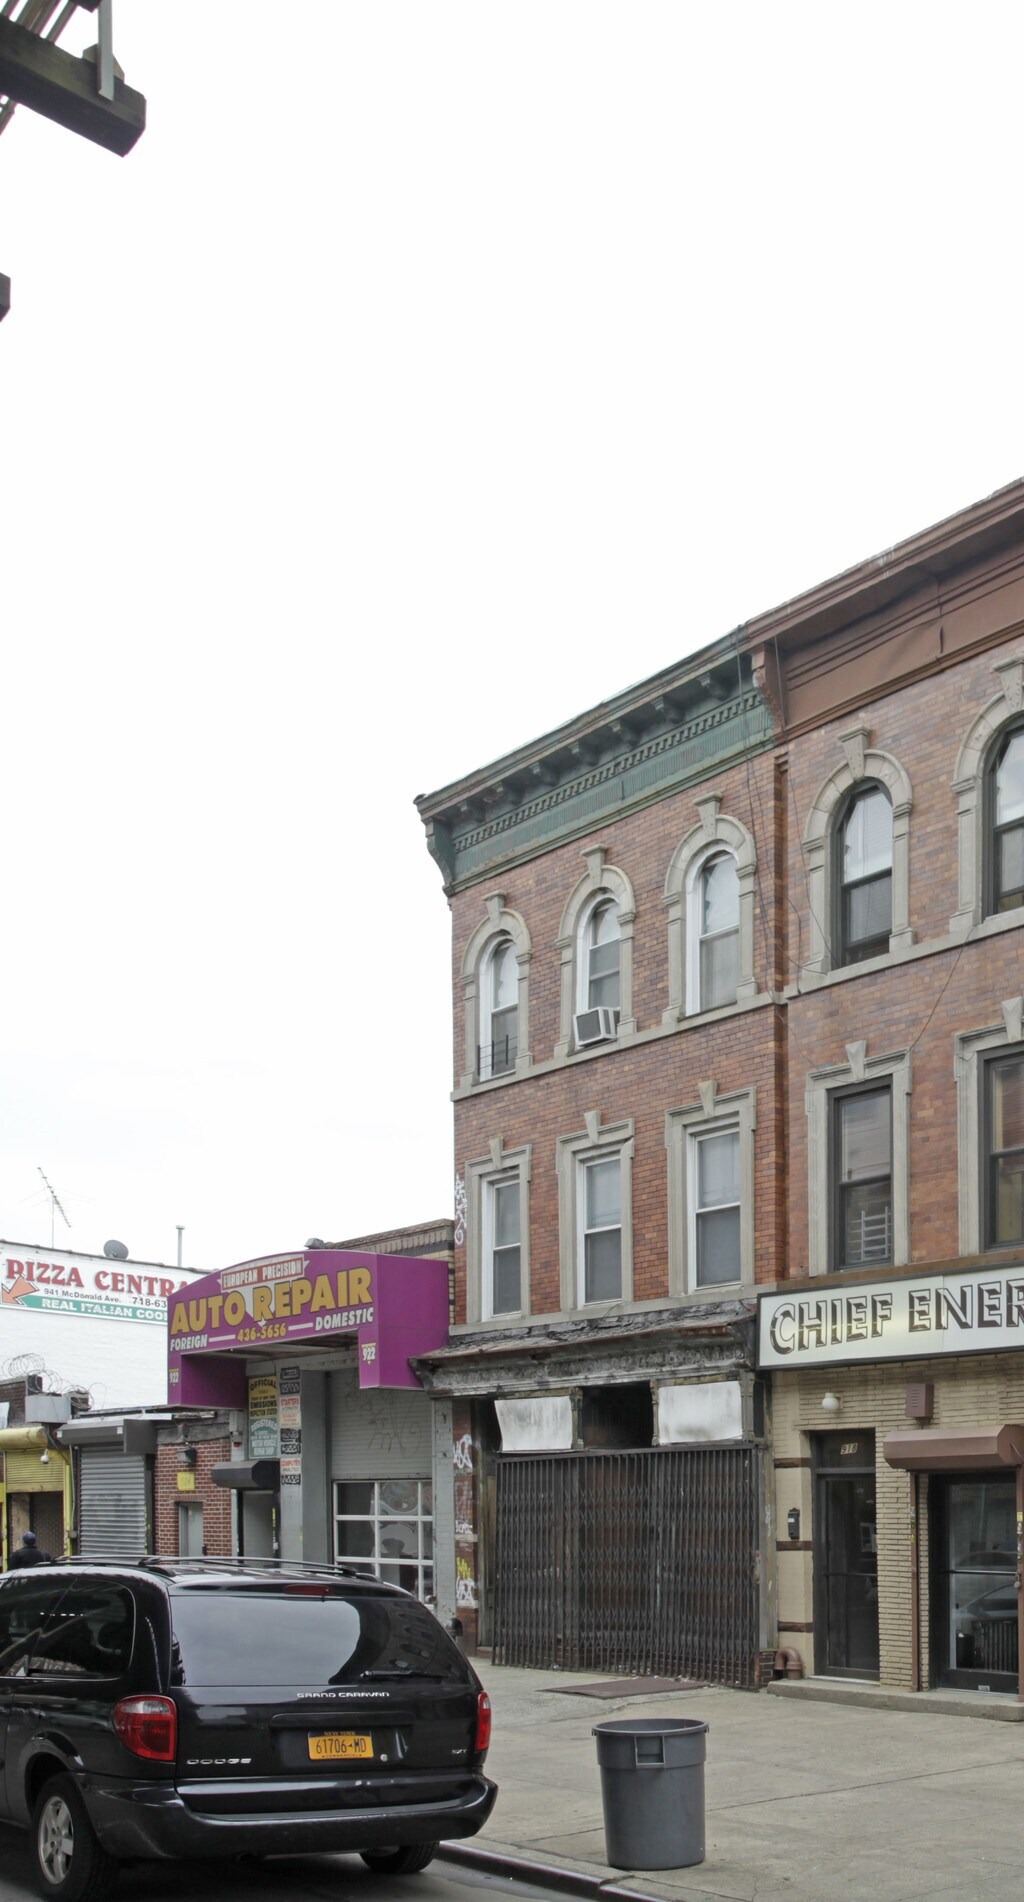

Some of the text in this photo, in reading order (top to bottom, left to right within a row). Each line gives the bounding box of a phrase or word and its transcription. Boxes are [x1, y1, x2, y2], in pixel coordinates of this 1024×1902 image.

[6, 1259, 84, 1288] PIZZA
[223, 1259, 301, 1287] EUROPEAN PRECISION
[42, 1298, 77, 1311] REAL
[81, 1303, 132, 1317] ITALIAN
[44, 1288, 121, 1303] 941 McDonald Ave.
[170, 1267, 374, 1335] AUTO REPAIR
[170, 1307, 374, 1351] FOREIGN 436-5656 DOMESTIC
[770, 1293, 893, 1355] CHIEF
[362, 1347, 376, 1360] 922
[250, 1379, 277, 1391] OFFICIAL
